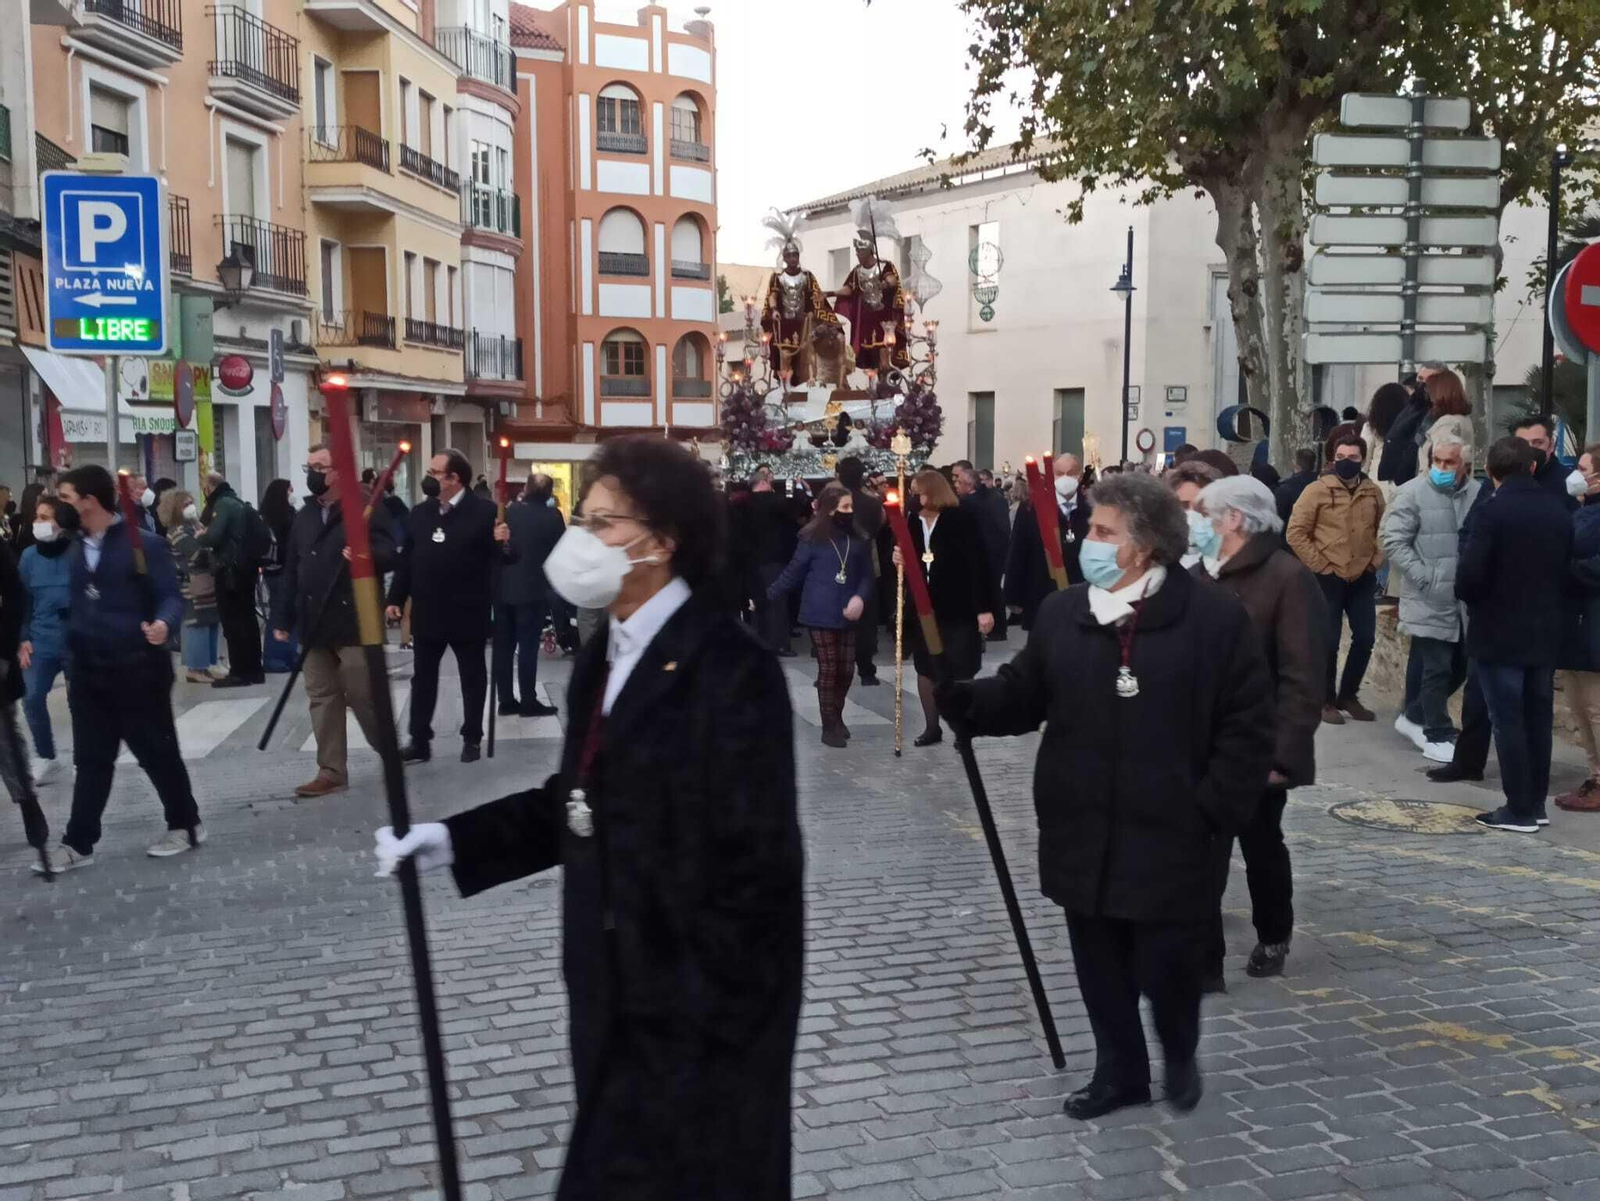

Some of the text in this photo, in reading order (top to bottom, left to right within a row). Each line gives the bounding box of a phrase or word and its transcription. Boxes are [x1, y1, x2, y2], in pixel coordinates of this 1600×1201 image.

[78, 200, 127, 263] P
[55, 277, 154, 291] PLAZA NUEVA
[79, 317, 150, 342] LIBRE
